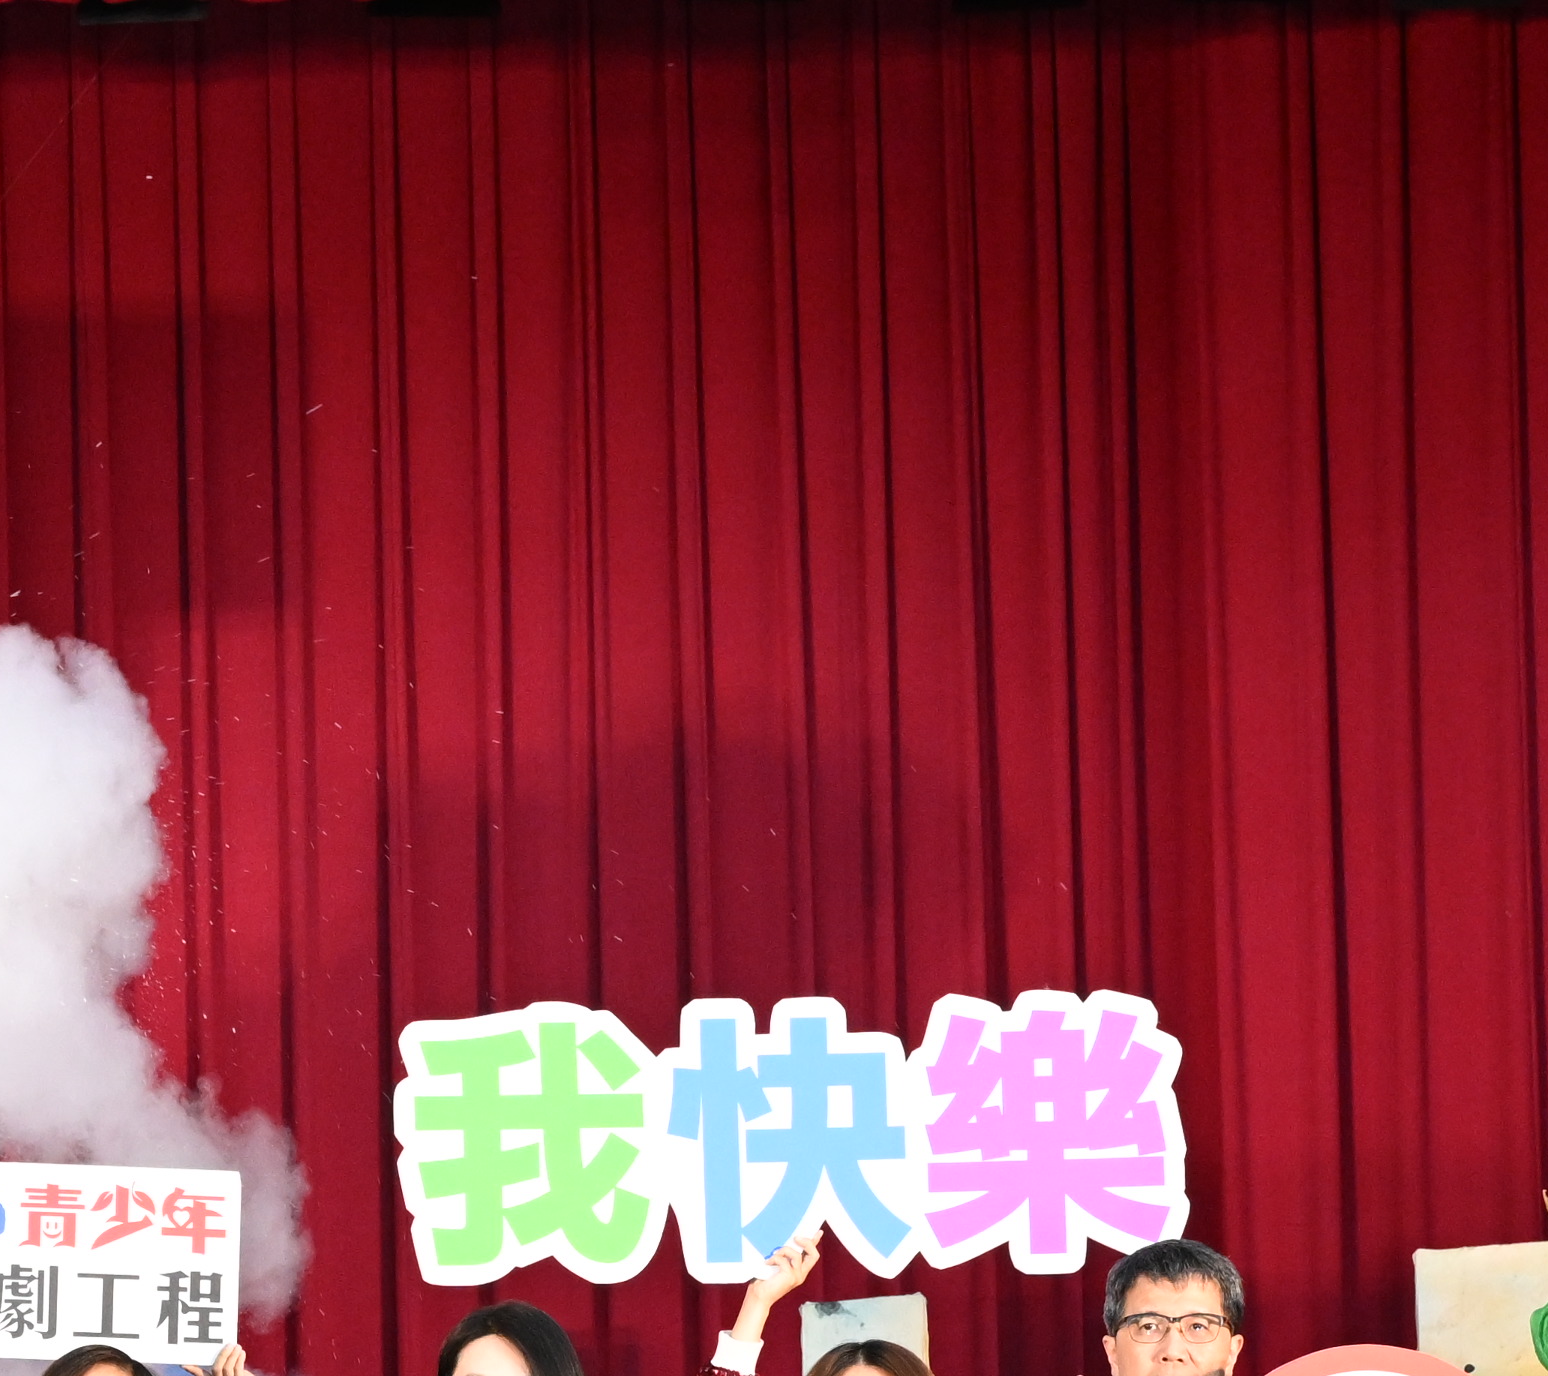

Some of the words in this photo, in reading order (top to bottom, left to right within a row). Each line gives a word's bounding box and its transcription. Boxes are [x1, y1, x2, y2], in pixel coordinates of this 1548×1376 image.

[19, 1181, 227, 1254] 青少年
[414, 1006, 1174, 1268] 我快樂
